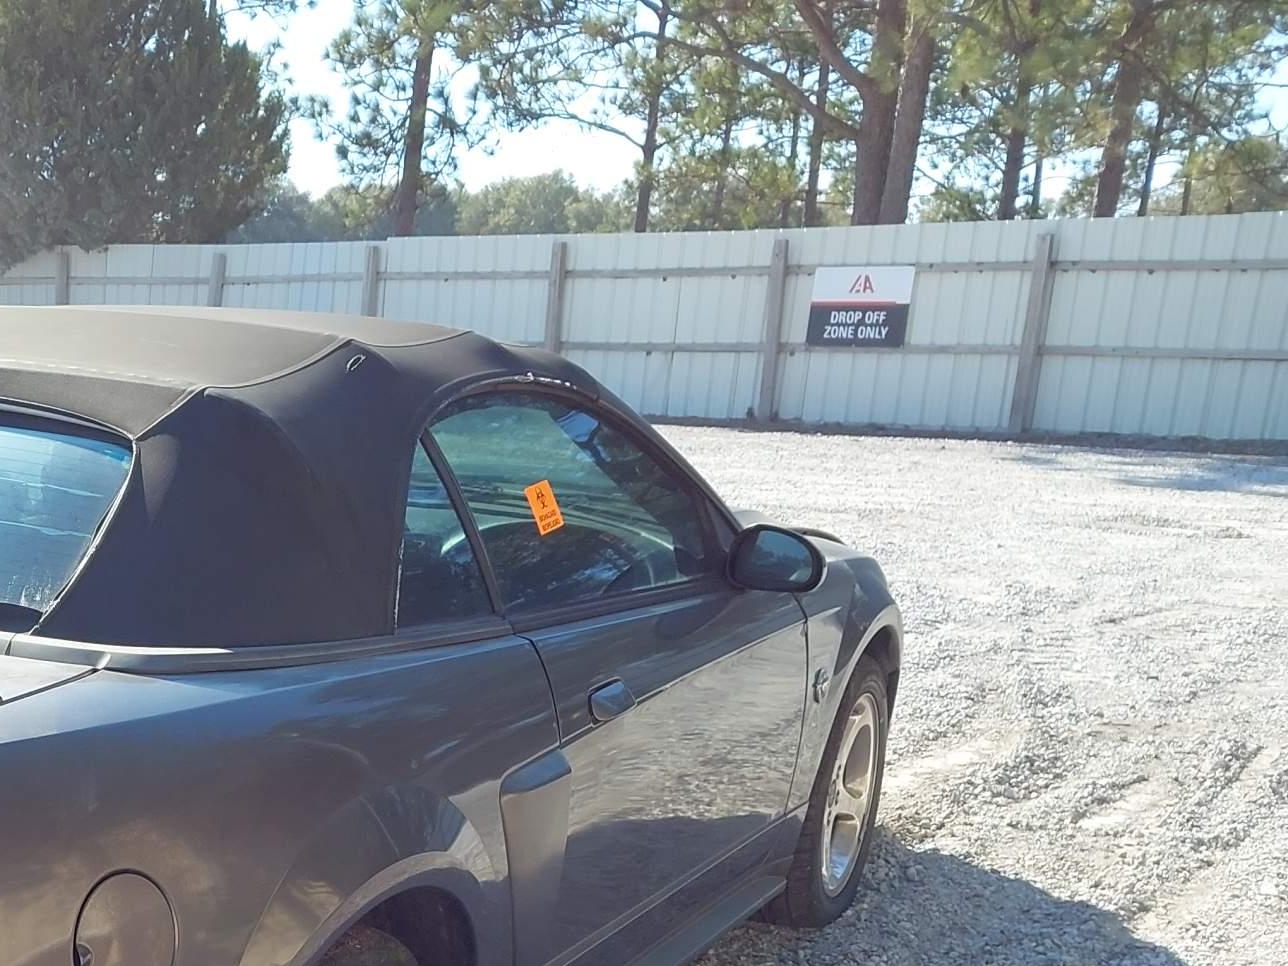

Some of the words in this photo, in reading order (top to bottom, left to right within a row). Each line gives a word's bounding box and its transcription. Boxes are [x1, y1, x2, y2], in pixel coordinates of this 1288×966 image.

[830, 311, 862, 324] DROP
[865, 311, 887, 324] OFF
[823, 326, 855, 338] ZONE
[857, 326, 889, 339] ONLY
